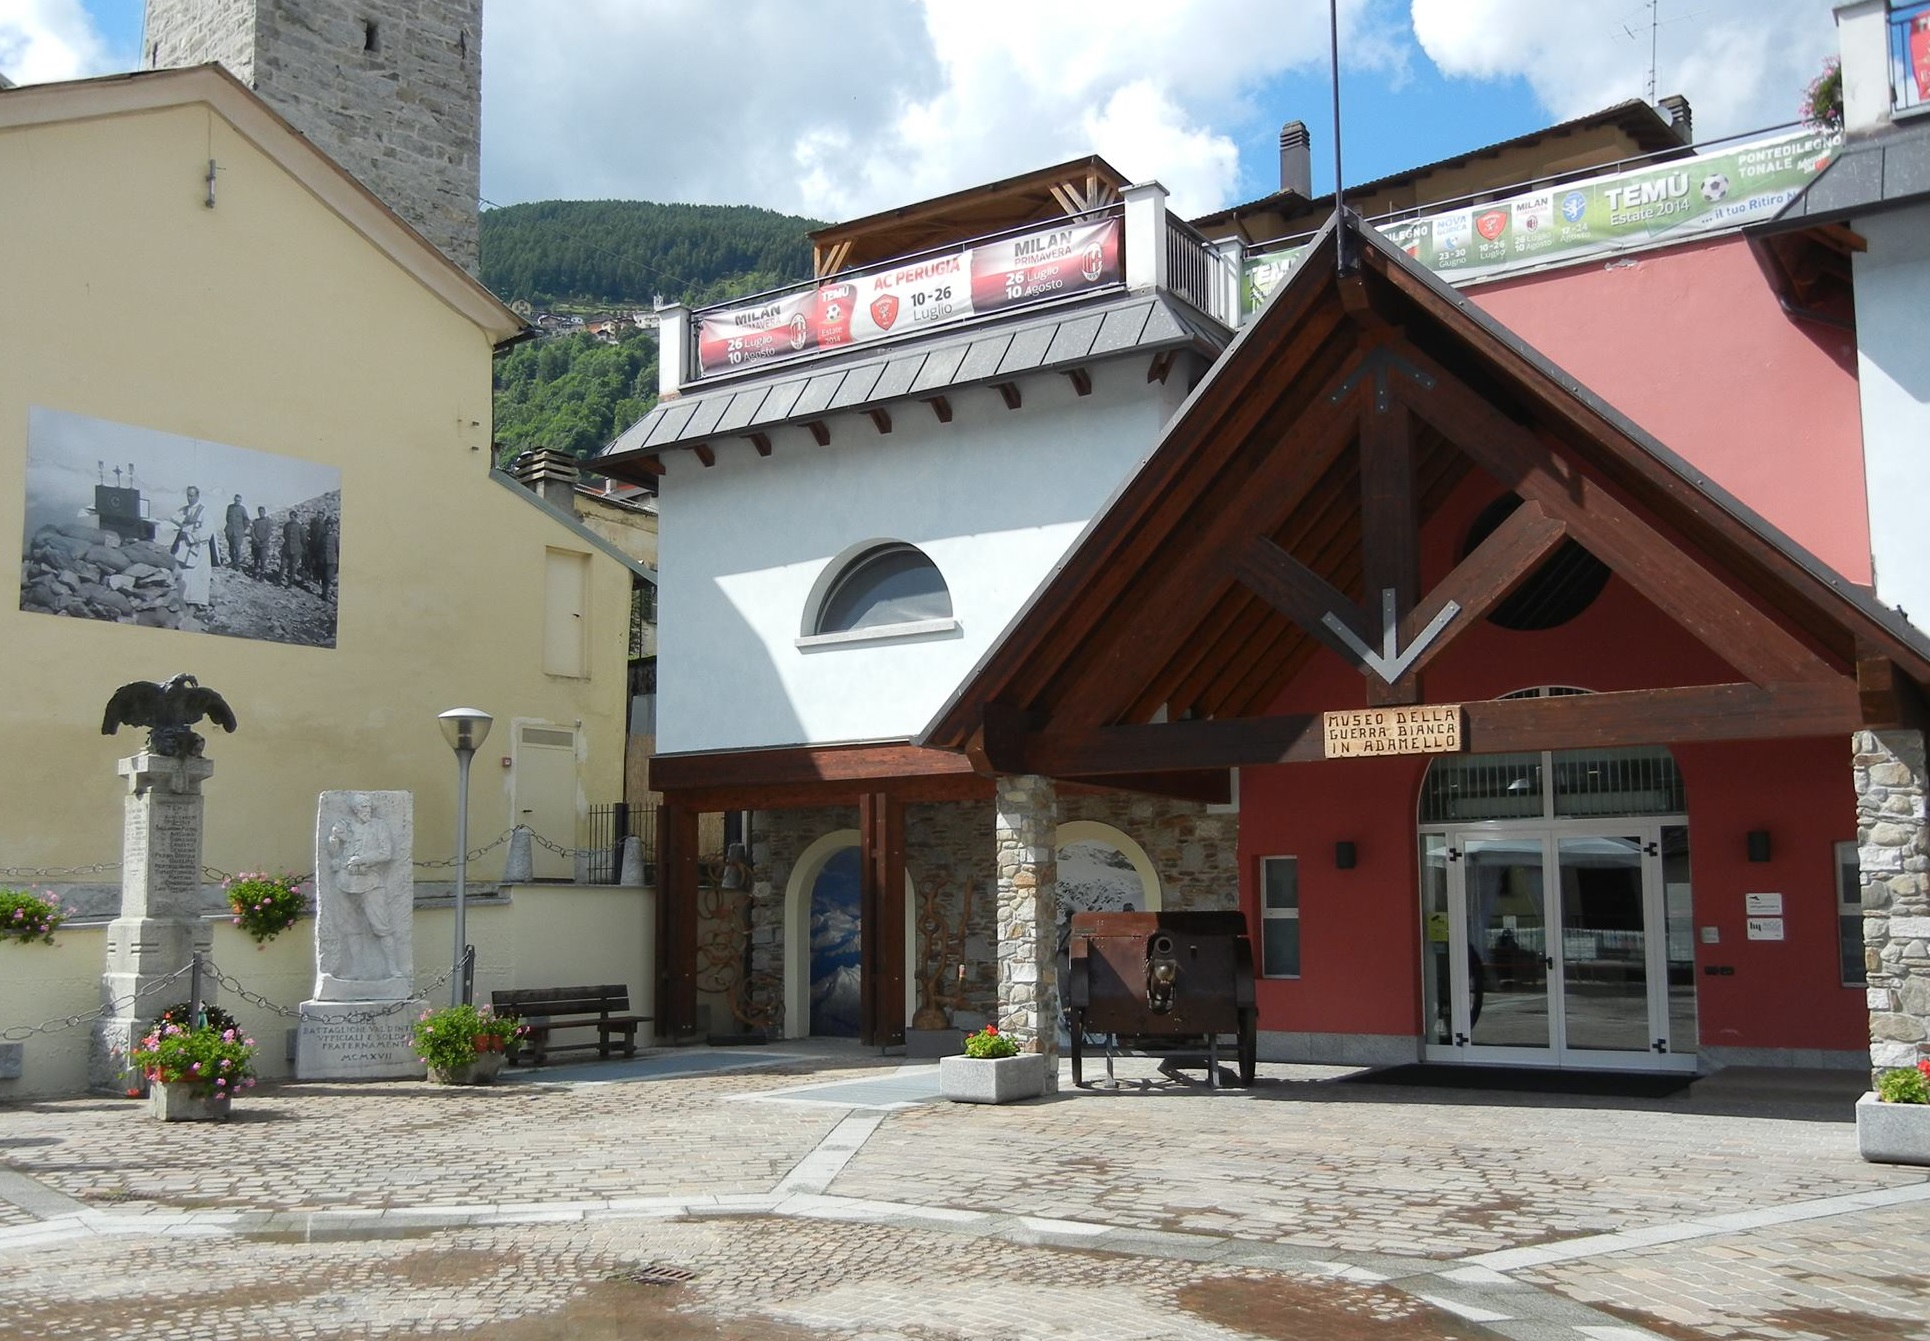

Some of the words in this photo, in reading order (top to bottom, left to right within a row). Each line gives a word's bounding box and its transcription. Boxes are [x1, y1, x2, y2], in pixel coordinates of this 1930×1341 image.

[1739, 158, 1793, 178] TONALE
[1604, 171, 1690, 212] TEMÙ
[1516, 197, 1549, 211] MILAN
[1610, 208, 1655, 227] Estate
[1656, 199, 1690, 216] 2014
[1727, 203, 1746, 215] tuo
[1748, 193, 1784, 211] Ritiro
[1437, 215, 1467, 229] NOVA
[1014, 230, 1073, 257] MILAN
[1514, 243, 1525, 253] 10
[1014, 245, 1072, 268] PRIMAVERA
[1438, 257, 1467, 268] Giugno
[874, 274, 893, 292] AC
[895, 256, 961, 286] PERUGIA
[1005, 270, 1025, 286] 26
[1026, 266, 1060, 282] Luglio
[1005, 285, 1022, 299] 10
[1024, 279, 1063, 297] Agosto
[734, 304, 781, 327] MILAN
[913, 302, 953, 321] Luglio
[821, 325, 843, 336] Estate
[727, 338, 743, 352] 26
[744, 335, 773, 349] Luglio
[728, 351, 741, 365] 10
[743, 346, 775, 363] Agosto
[1328, 713, 1384, 727] MUSEO
[1396, 709, 1455, 724] DELLA
[1330, 726, 1387, 740] GUERRA
[1398, 723, 1456, 737] BIANCA
[1332, 741, 1350, 754] IN
[1363, 735, 1456, 752] ADAMELLO
[340, 1052, 392, 1061] MCMXVII
